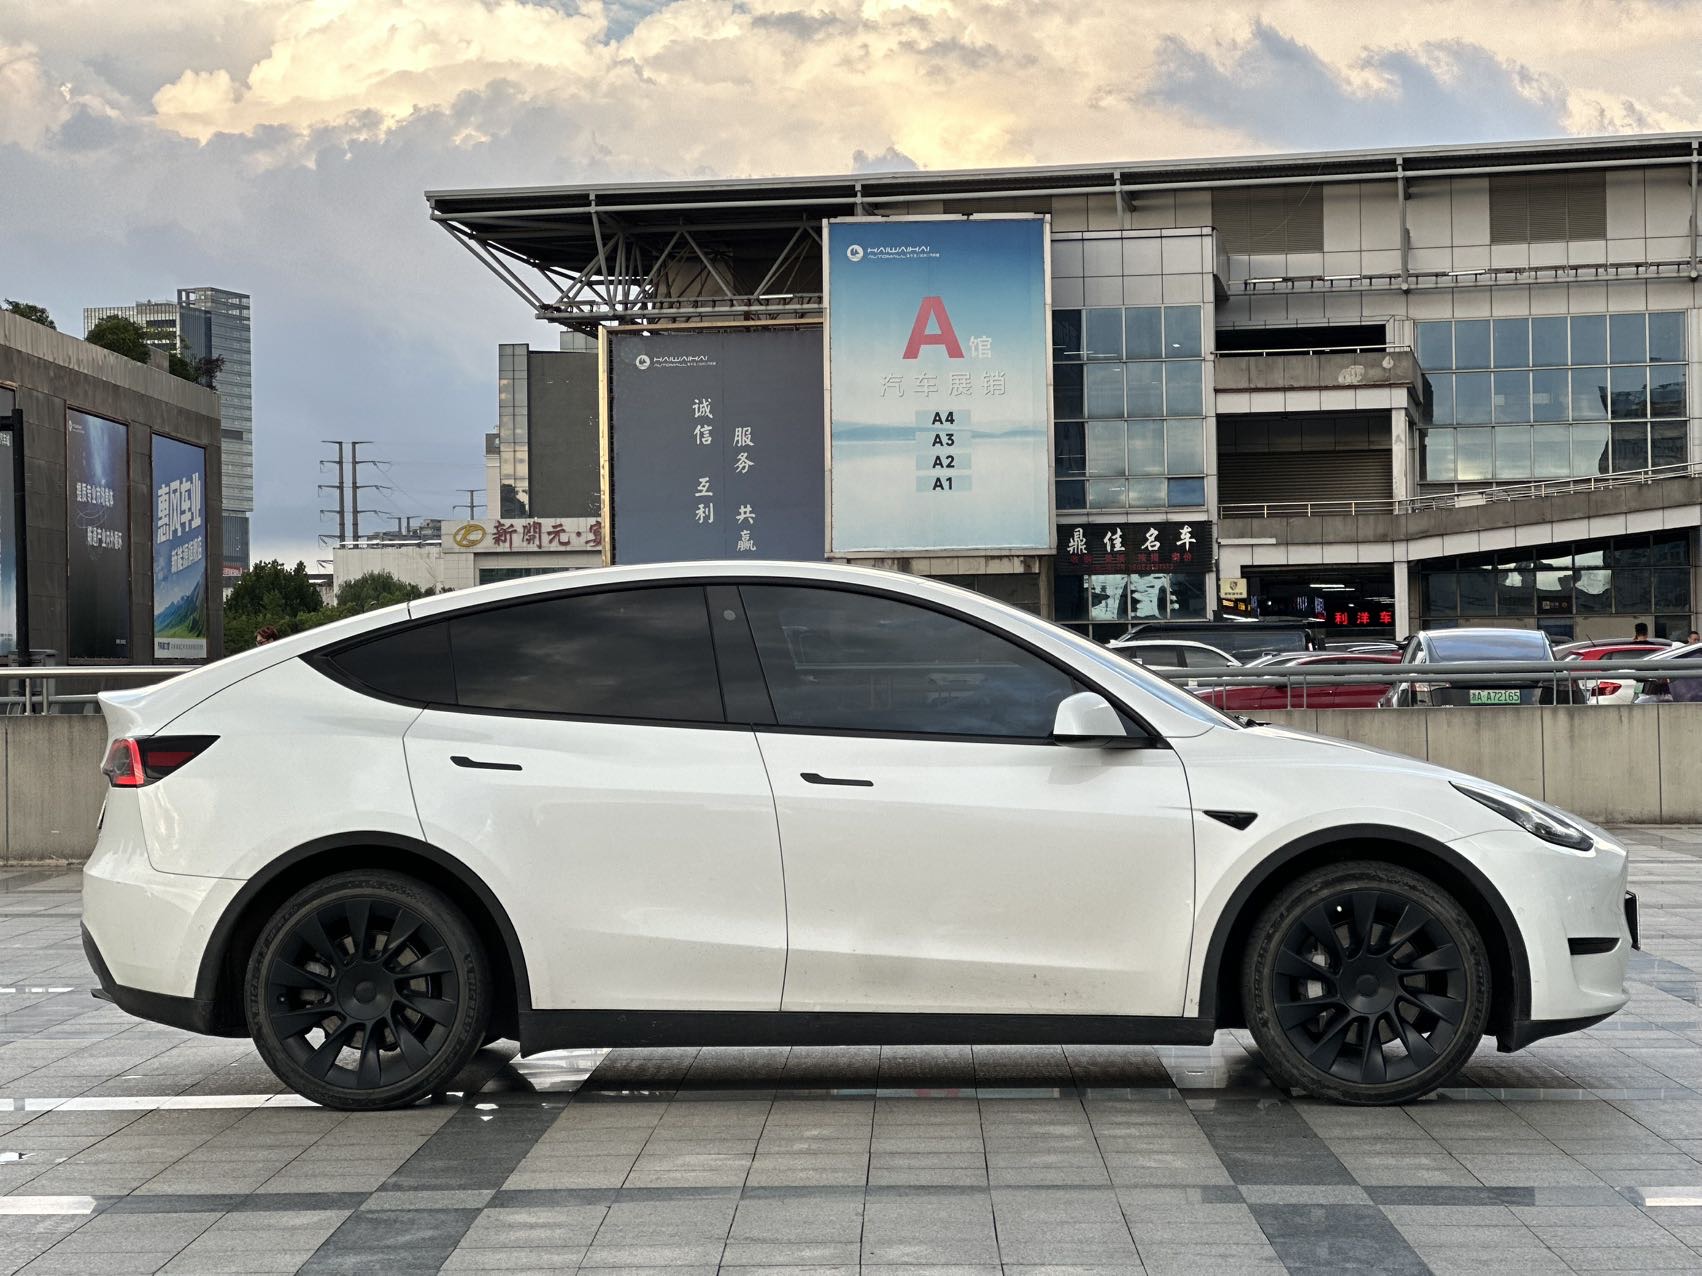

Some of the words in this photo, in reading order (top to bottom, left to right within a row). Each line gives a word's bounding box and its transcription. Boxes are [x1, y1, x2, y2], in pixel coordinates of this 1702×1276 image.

[902, 296, 965, 359] A
[969, 335, 992, 359] 馆
[879, 370, 1007, 397] 汽车展销
[692, 398, 713, 445] 诚信
[931, 411, 956, 425] A4
[733, 427, 755, 474] 服务
[931, 433, 955, 447] A3
[932, 455, 955, 469] A2
[932, 477, 954, 491] A1
[157, 472, 201, 544] 惠风车业
[695, 477, 714, 524] 互利
[736, 504, 757, 552] 共赢
[1066, 524, 1197, 554] 鼎佳名车
[1316, 611, 1392, 625] 利洋车
[1487, 691, 1520, 702] A72165
